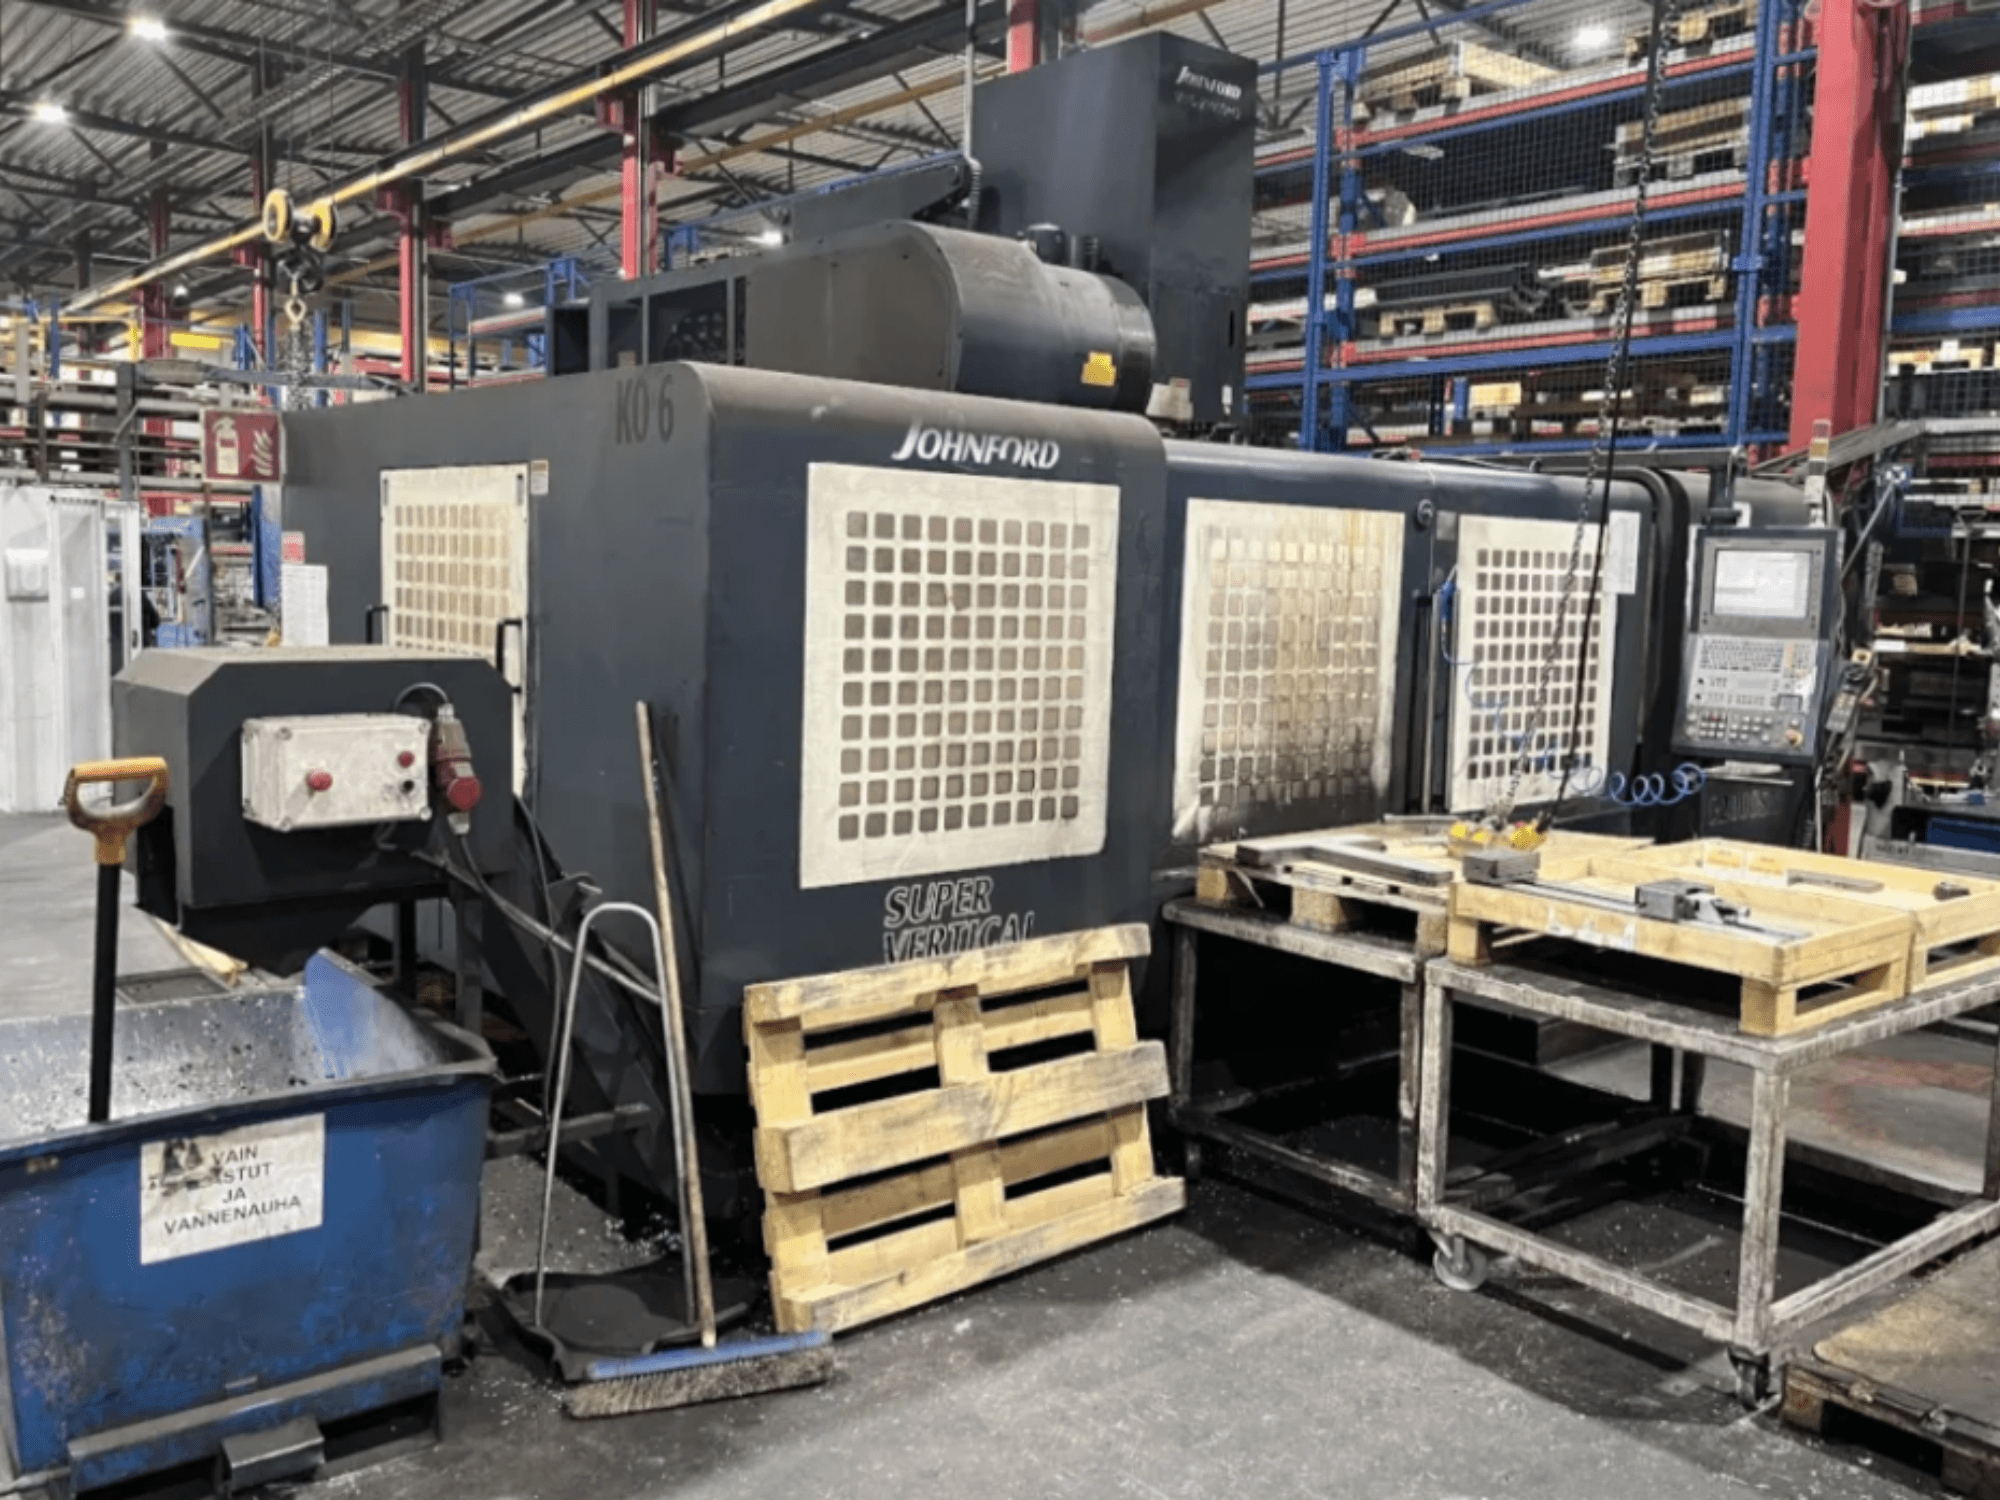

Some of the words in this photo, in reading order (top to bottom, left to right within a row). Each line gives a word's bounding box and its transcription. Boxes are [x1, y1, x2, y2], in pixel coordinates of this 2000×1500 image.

[891, 416, 1060, 470] JOHNFORD
[884, 876, 994, 928] SUPER
[212, 1145, 258, 1166] VAIN
[212, 1162, 272, 1184] STUT
[222, 1187, 246, 1203] JA
[164, 1195, 301, 1234] VANNENAUHA
